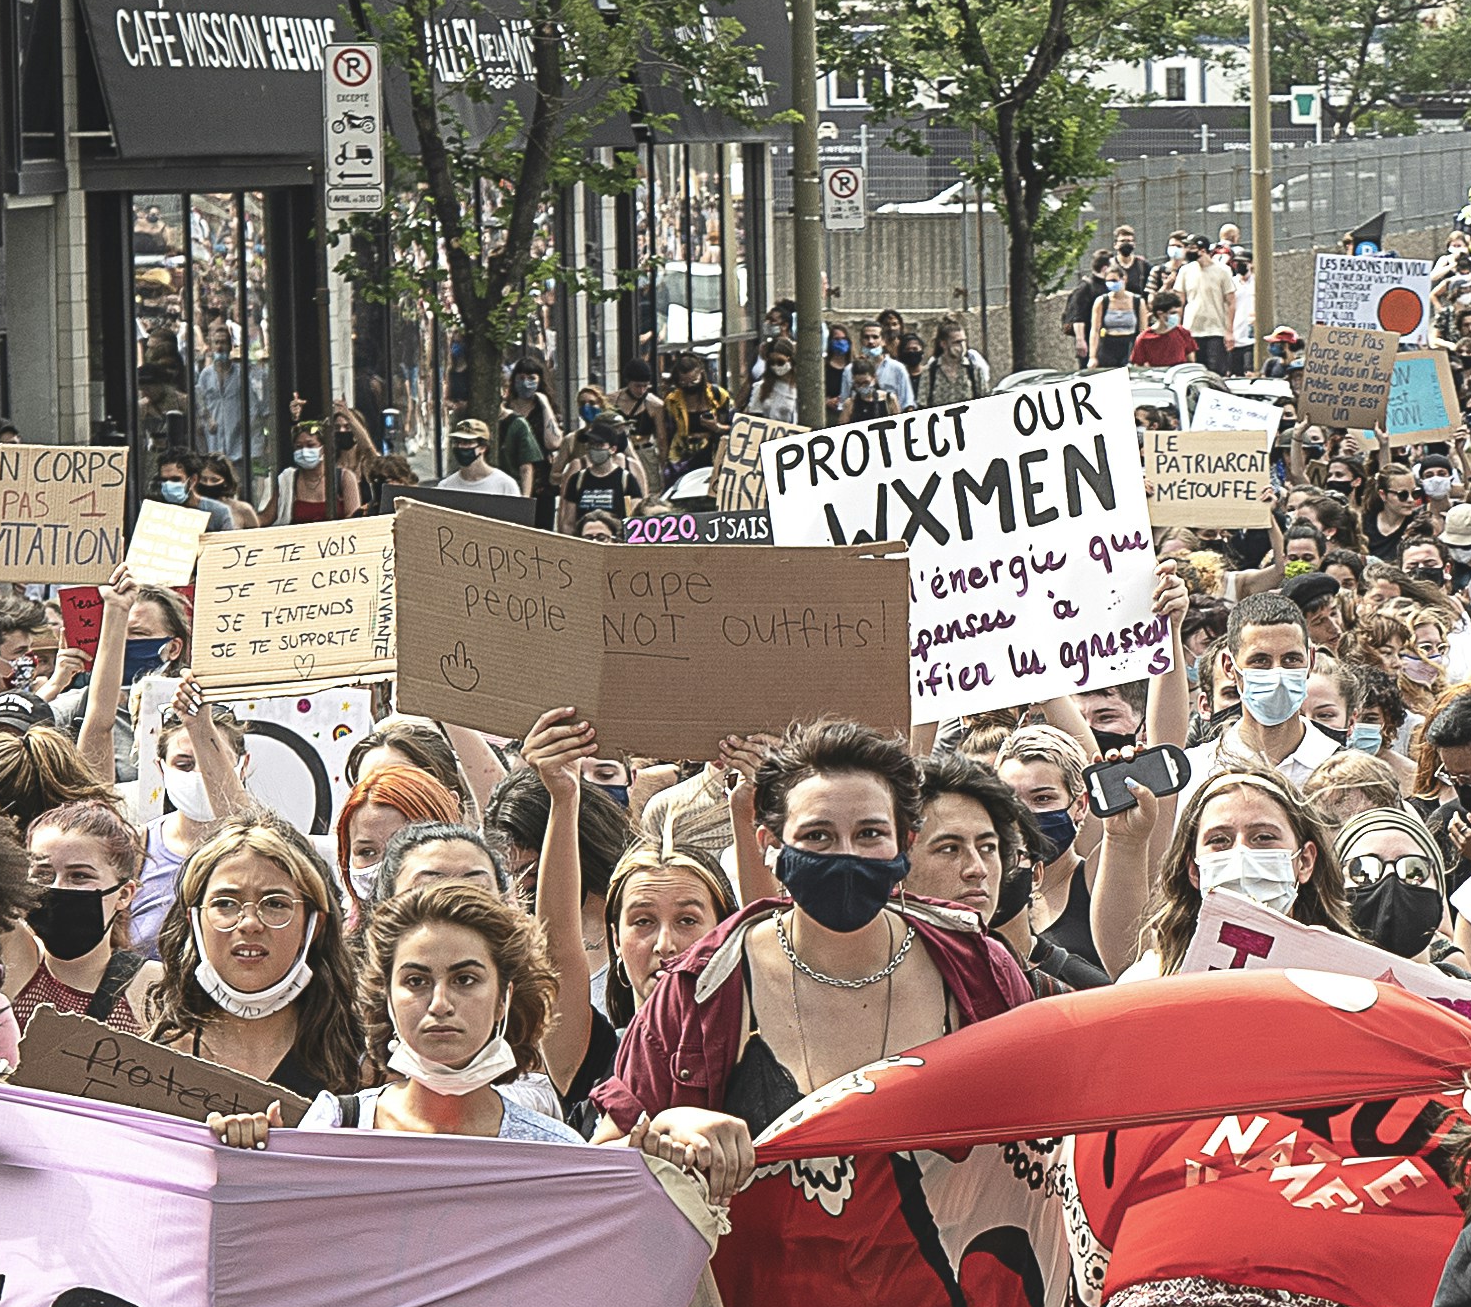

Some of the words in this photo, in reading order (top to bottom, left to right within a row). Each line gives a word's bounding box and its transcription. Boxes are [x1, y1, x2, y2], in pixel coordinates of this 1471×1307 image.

[175, 11, 268, 70] MISSION
[775, 404, 970, 495] PROTECT
[1014, 383, 1103, 438] OUR
[1153, 433, 1179, 455] LE
[33, 450, 126, 489] CORPS
[1155, 450, 1269, 474] PATRIARCAT
[3, 491, 50, 519] PAS
[824, 434, 1117, 549] WXMEN
[1157, 479, 1258, 502] M'ÉTOUFFE
[626, 513, 700, 544] 2020,
[705, 516, 769, 542] J'SAIS
[222, 545, 264, 570] JE
[274, 543, 305, 563] TE
[317, 534, 358, 559] VOIS
[1089, 526, 1150, 574] que
[214, 582, 256, 604] JE
[267, 577, 299, 595] TE
[311, 566, 370, 589] CROIS
[435, 525, 575, 590] Rapists
[607, 565, 714, 619] rape
[216, 613, 246, 633] JE
[261, 597, 355, 628] T'ENTENDS
[464, 584, 567, 634] people
[601, 612, 689, 648] NOT
[211, 642, 237, 658] JE
[249, 639, 272, 655] TE
[278, 627, 361, 651] SUPPORTE
[1007, 644, 1046, 678] les
